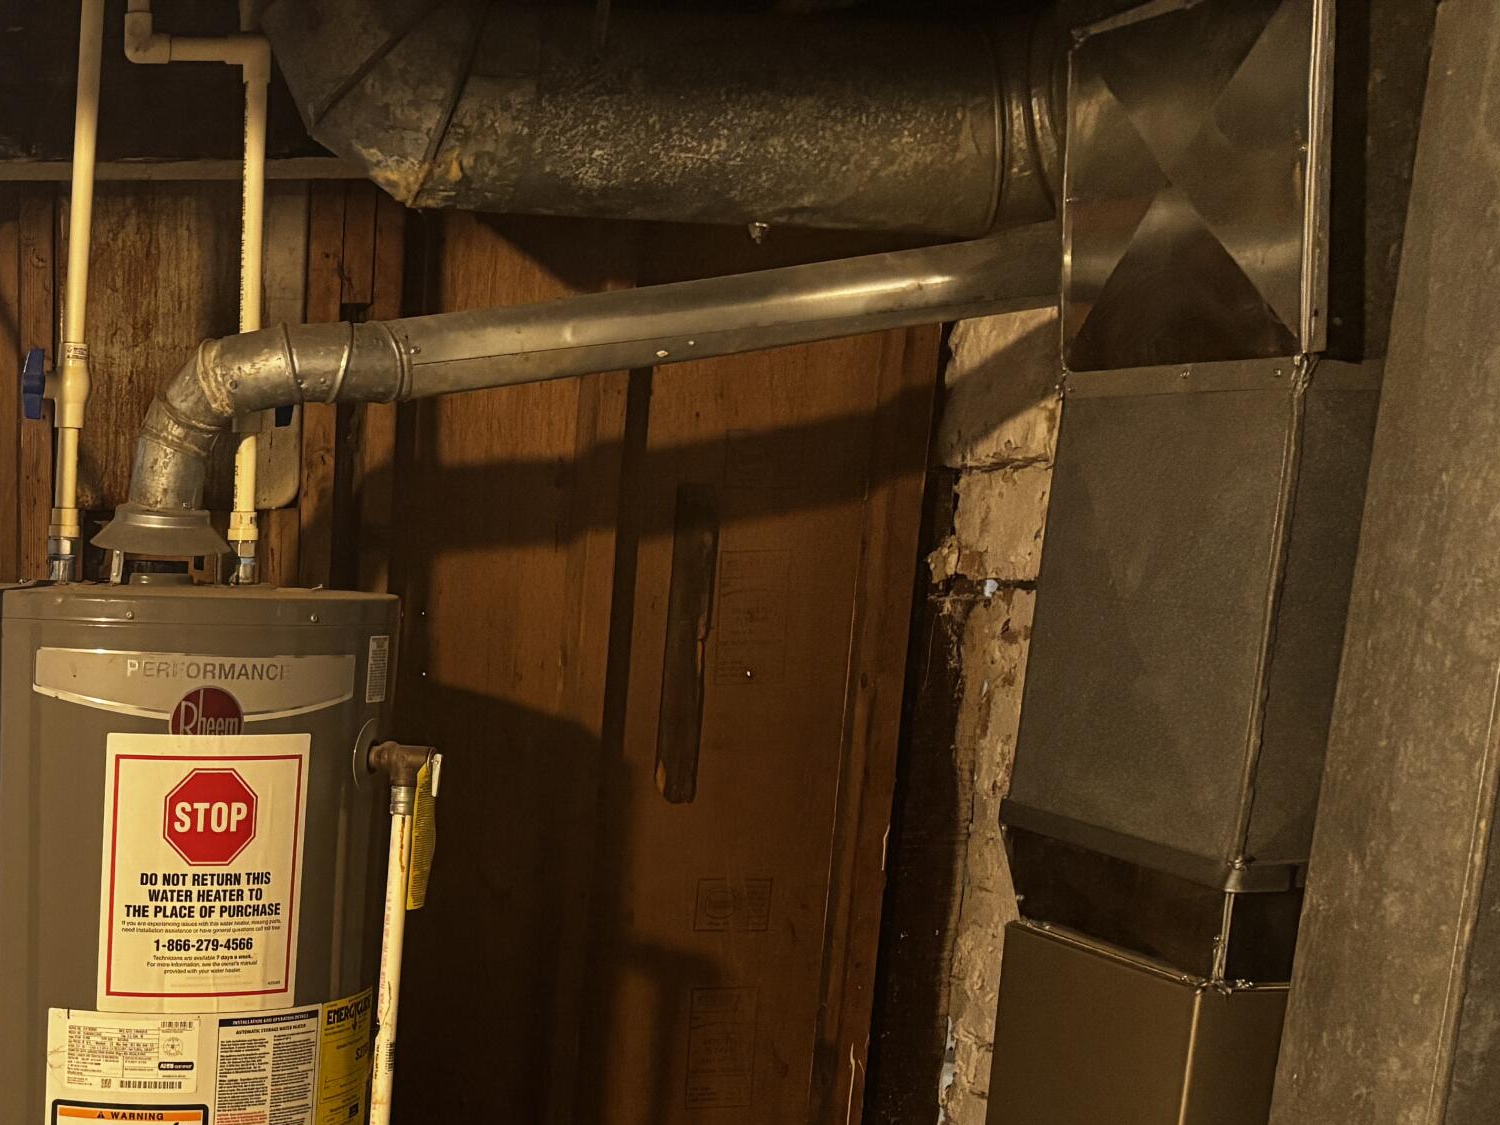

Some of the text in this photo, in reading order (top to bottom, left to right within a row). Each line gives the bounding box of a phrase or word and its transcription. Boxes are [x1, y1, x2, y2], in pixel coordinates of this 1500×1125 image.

[179, 689, 239, 735] Rheem
[173, 801, 248, 833] STOP
[140, 872, 271, 886] DO NOT RETURN THIS
[148, 888, 262, 902] WATER HEATER TO
[125, 903, 281, 918] THE PLACE OF PURCHASE
[154, 938, 253, 951] 1-866-279-4566
[111, 1111, 164, 1120] WARNING
